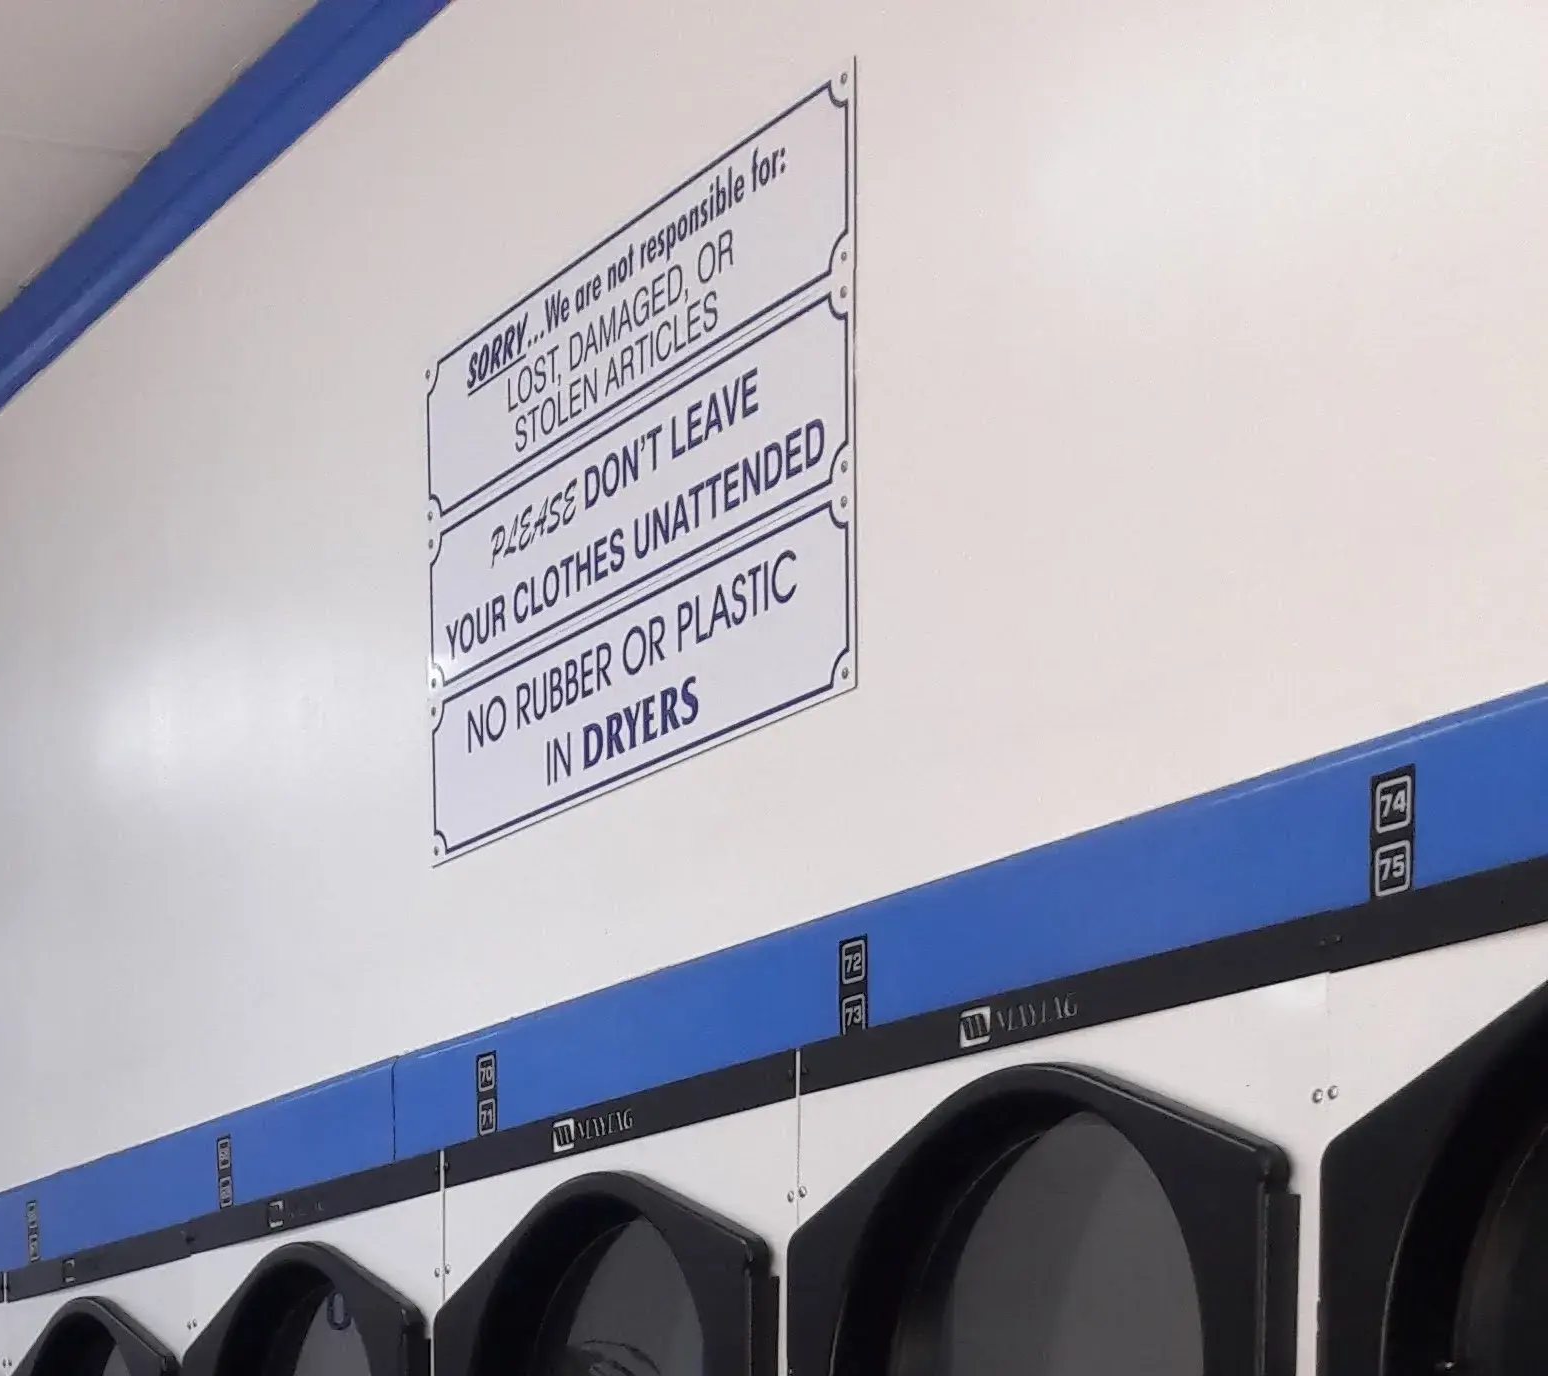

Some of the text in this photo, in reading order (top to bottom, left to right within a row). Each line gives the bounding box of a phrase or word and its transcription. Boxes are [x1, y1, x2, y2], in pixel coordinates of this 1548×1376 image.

[545, 292, 570, 334] We
[575, 275, 602, 313] are
[607, 244, 634, 293] not
[640, 166, 745, 264] responsible
[751, 146, 787, 192] for:
[507, 229, 735, 412] LOST, DAMAGED, OR
[514, 290, 719, 452] STOLEN ARTICLES
[490, 367, 759, 567] PLEASE DON'T LEAVE
[446, 417, 826, 660] YOUR CLOTHES UNATTENDED
[466, 549, 798, 754] NO RUBBER OR PLASTIC
[546, 675, 700, 786] IN DRYERS
[1378, 853, 1405, 881] 75
[1379, 789, 1407, 819] 74
[844, 952, 862, 974] 72
[845, 1004, 863, 1027] 73
[480, 1065, 494, 1082] 70
